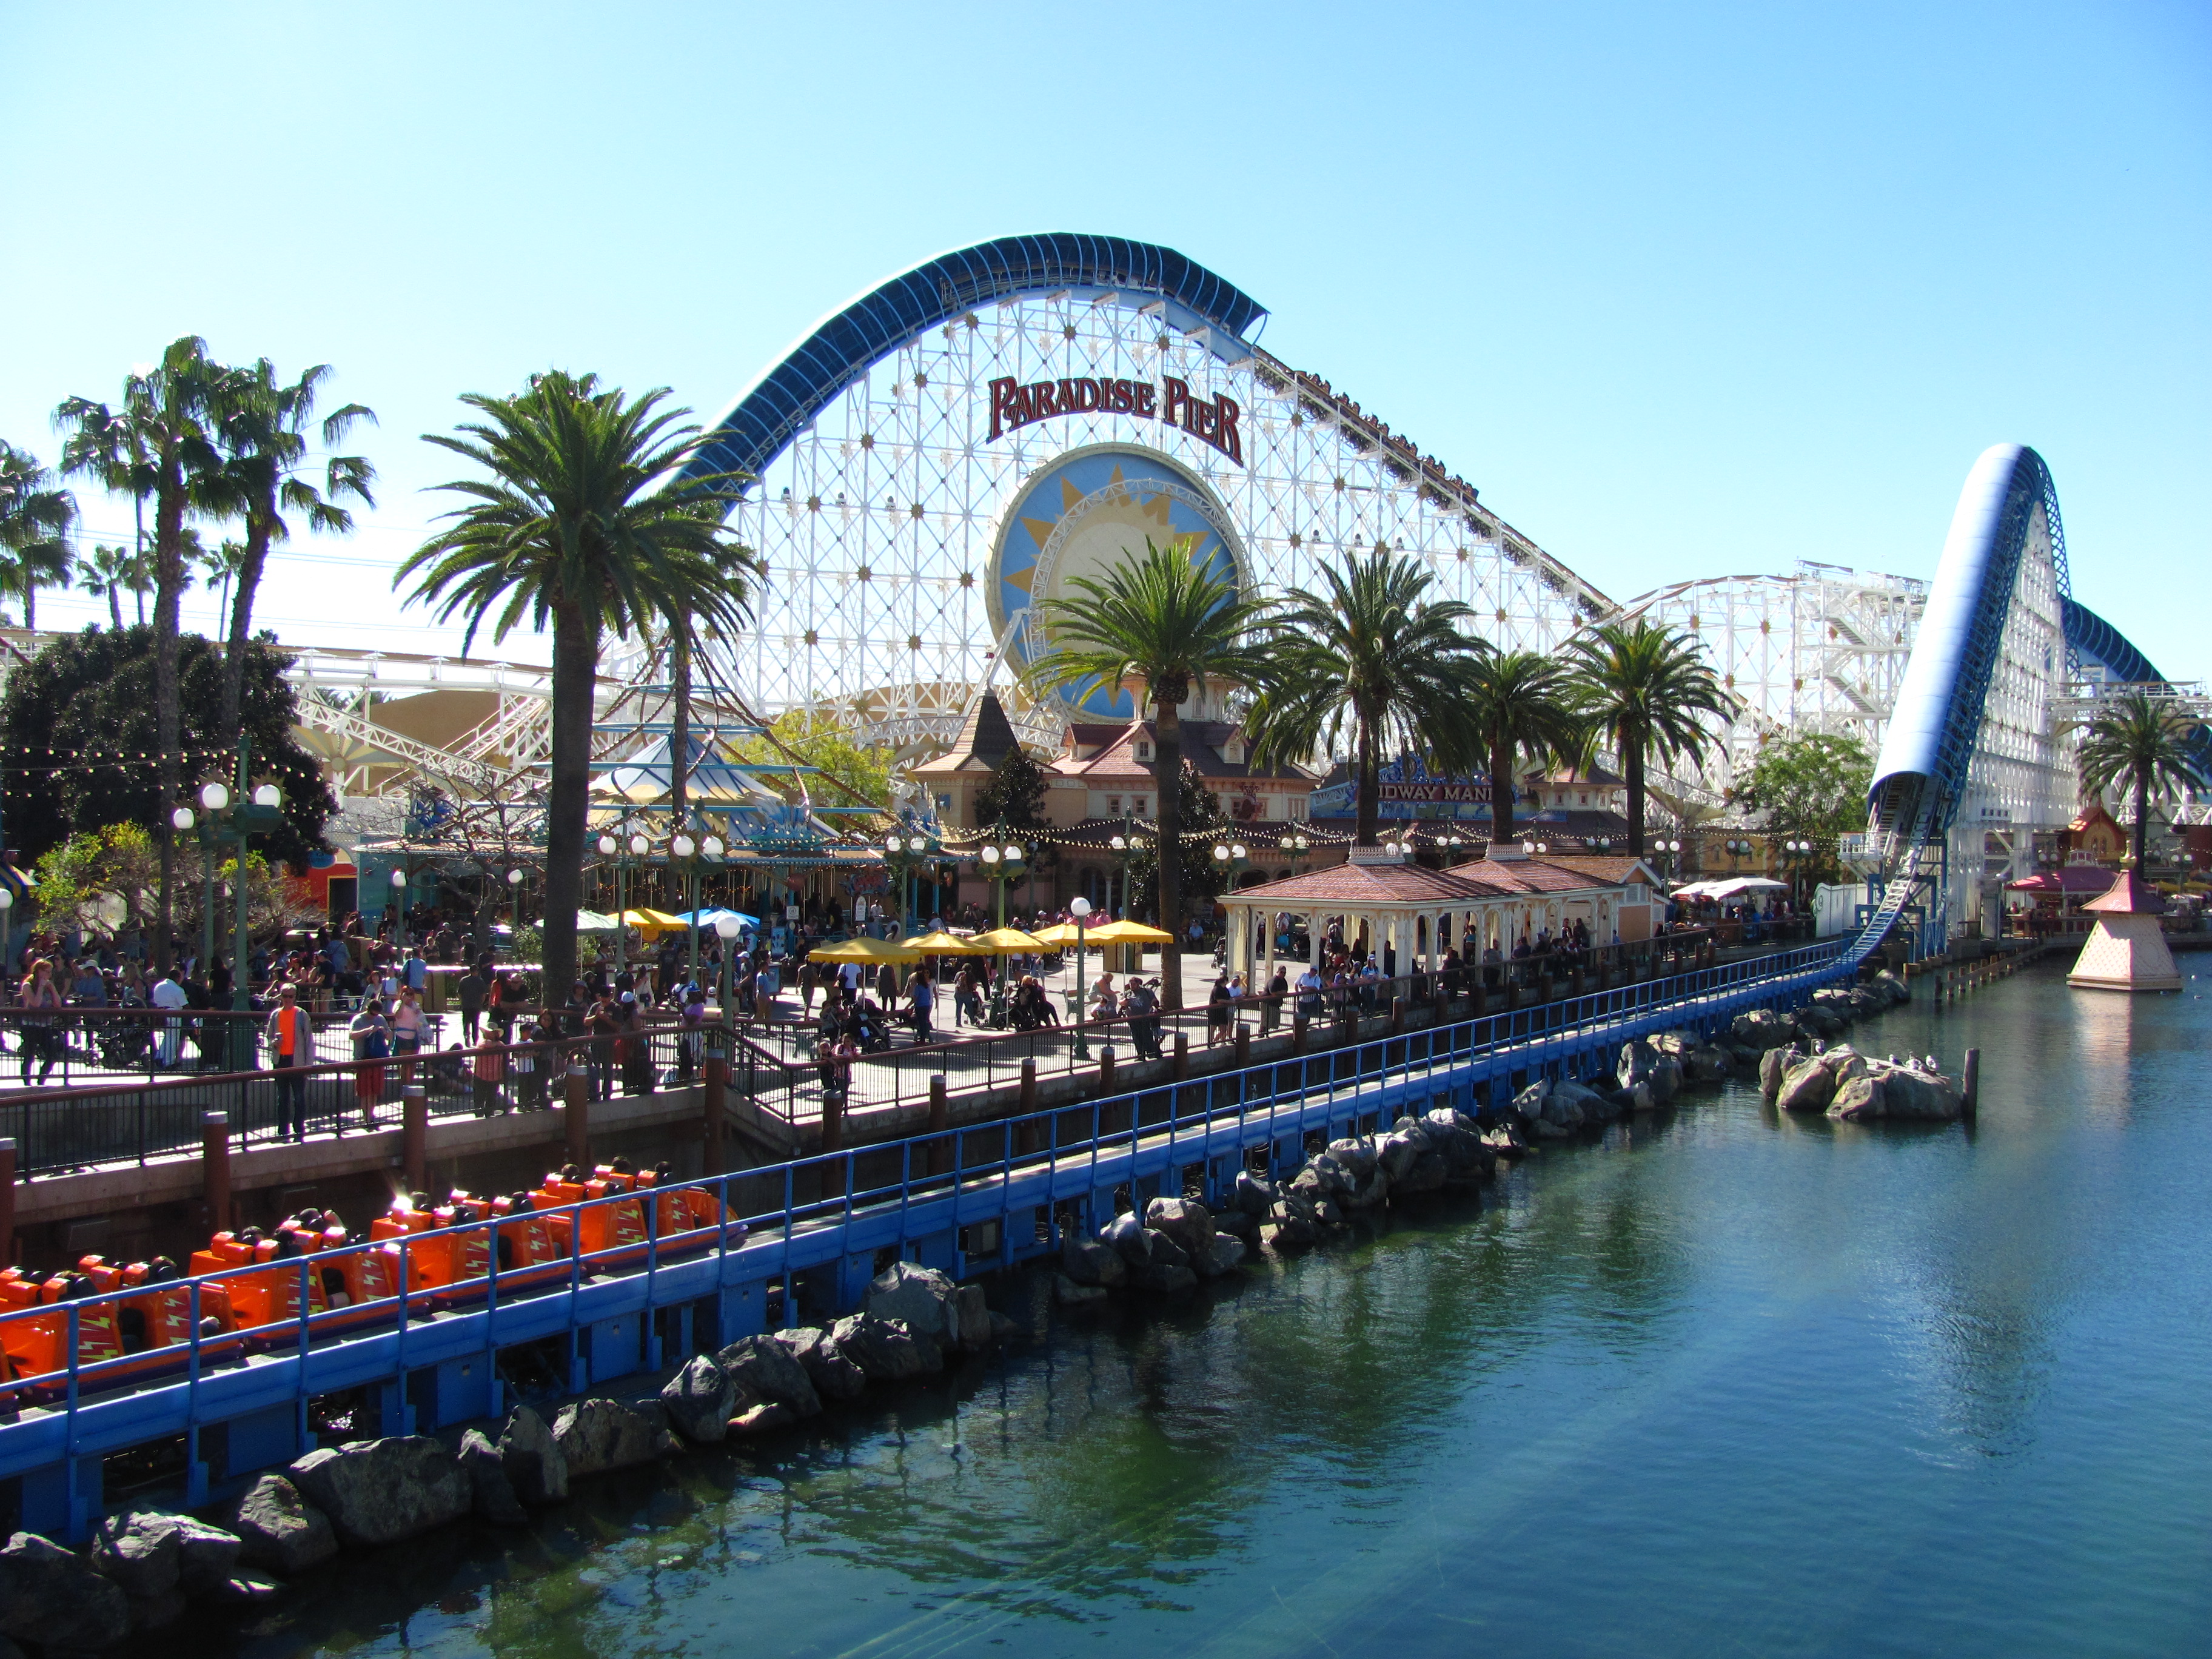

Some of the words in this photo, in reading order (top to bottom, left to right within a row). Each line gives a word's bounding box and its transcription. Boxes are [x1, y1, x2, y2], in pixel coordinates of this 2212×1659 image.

[986, 376, 1157, 445] PARADISE
[1162, 375, 1244, 468] PIER
[1378, 785, 1439, 800] IDWAY
[1444, 786, 1493, 801] MANI
